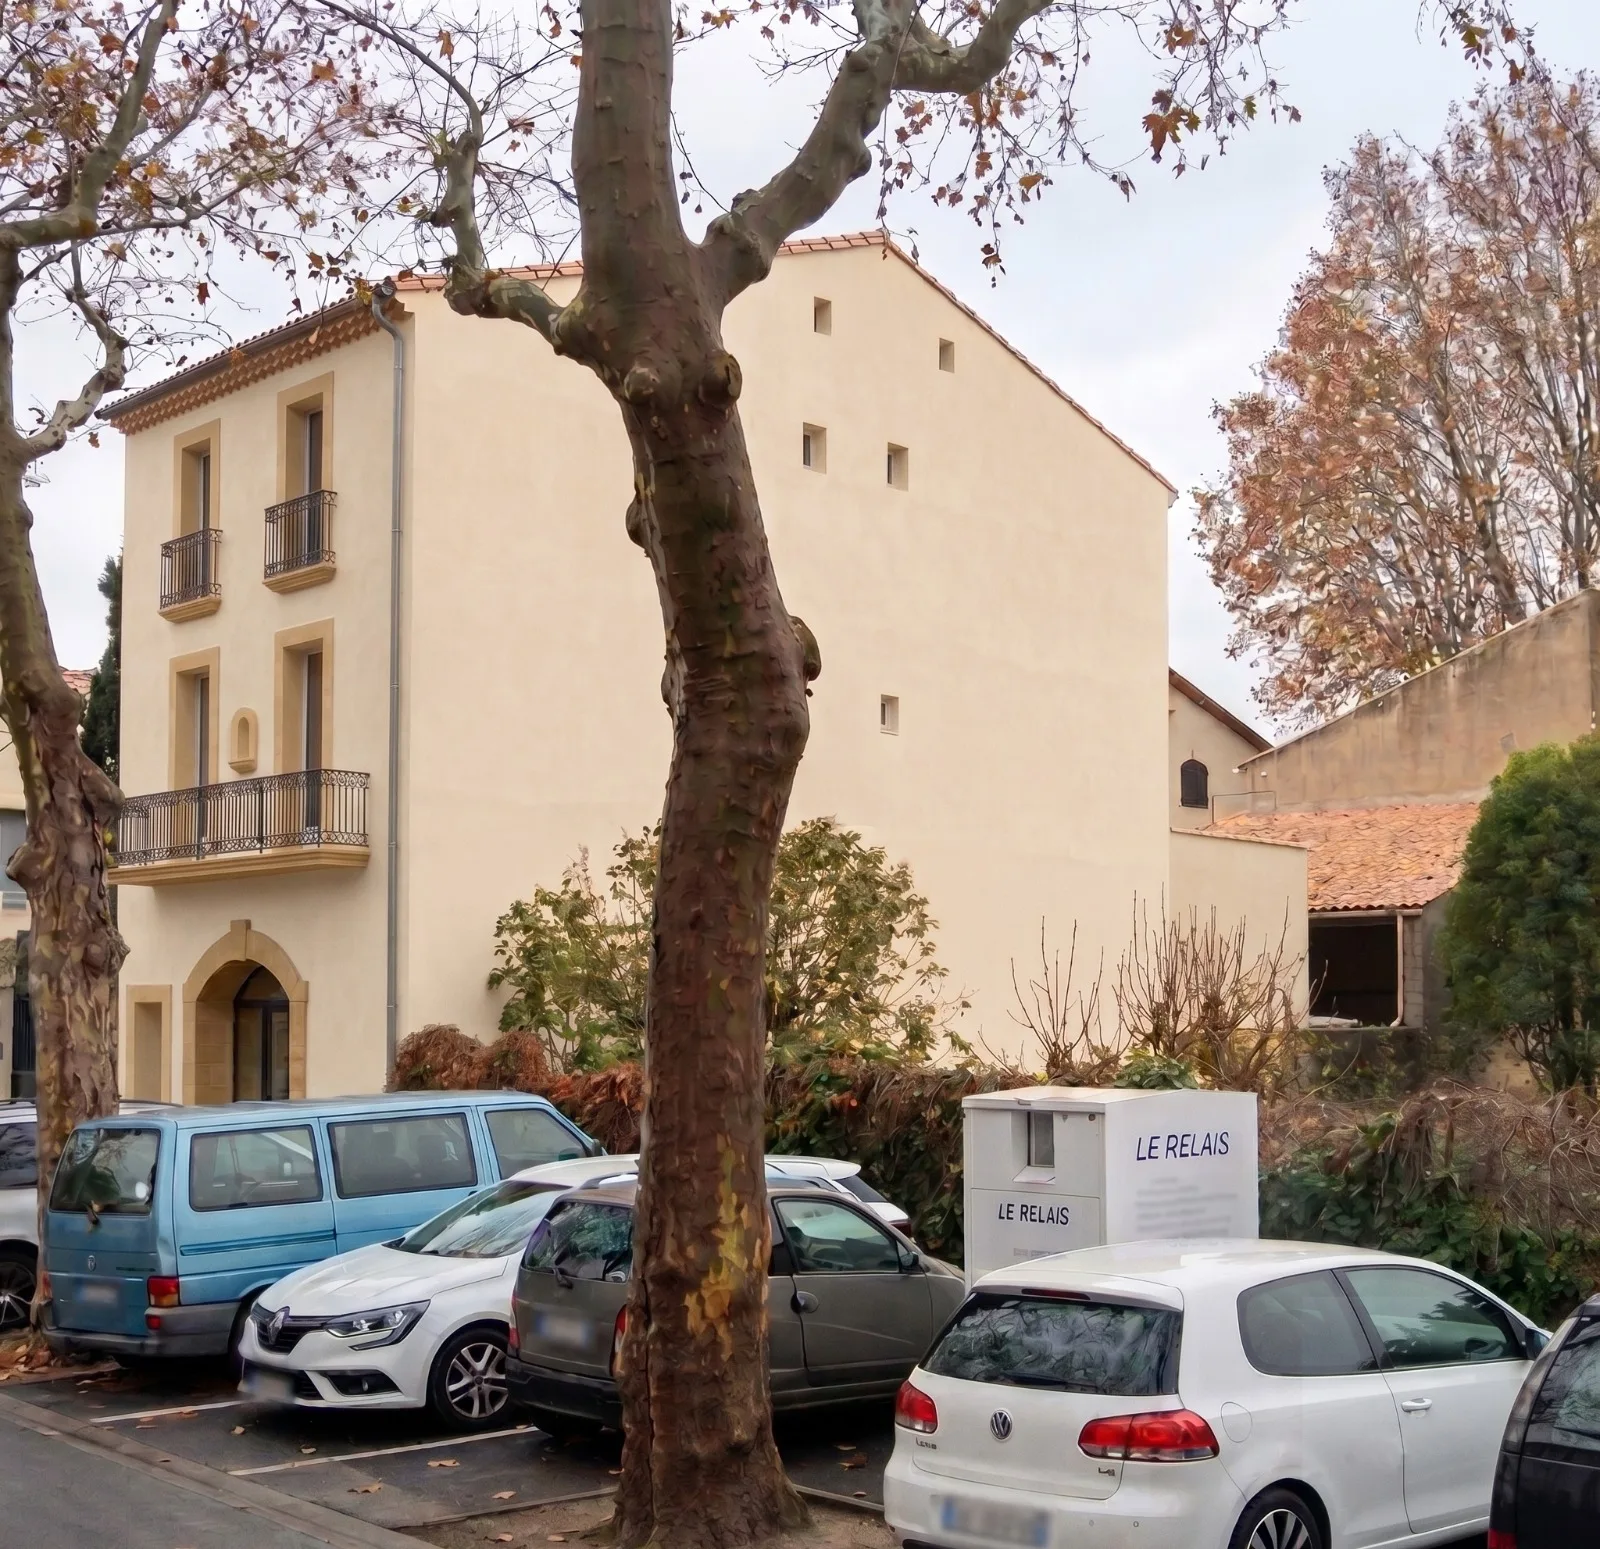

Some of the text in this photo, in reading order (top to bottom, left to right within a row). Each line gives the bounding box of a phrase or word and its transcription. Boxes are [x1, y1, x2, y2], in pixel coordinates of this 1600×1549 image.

[1136, 1131, 1230, 1161] LE RELAIS
[998, 1202, 1070, 1226] LE RELAIS
